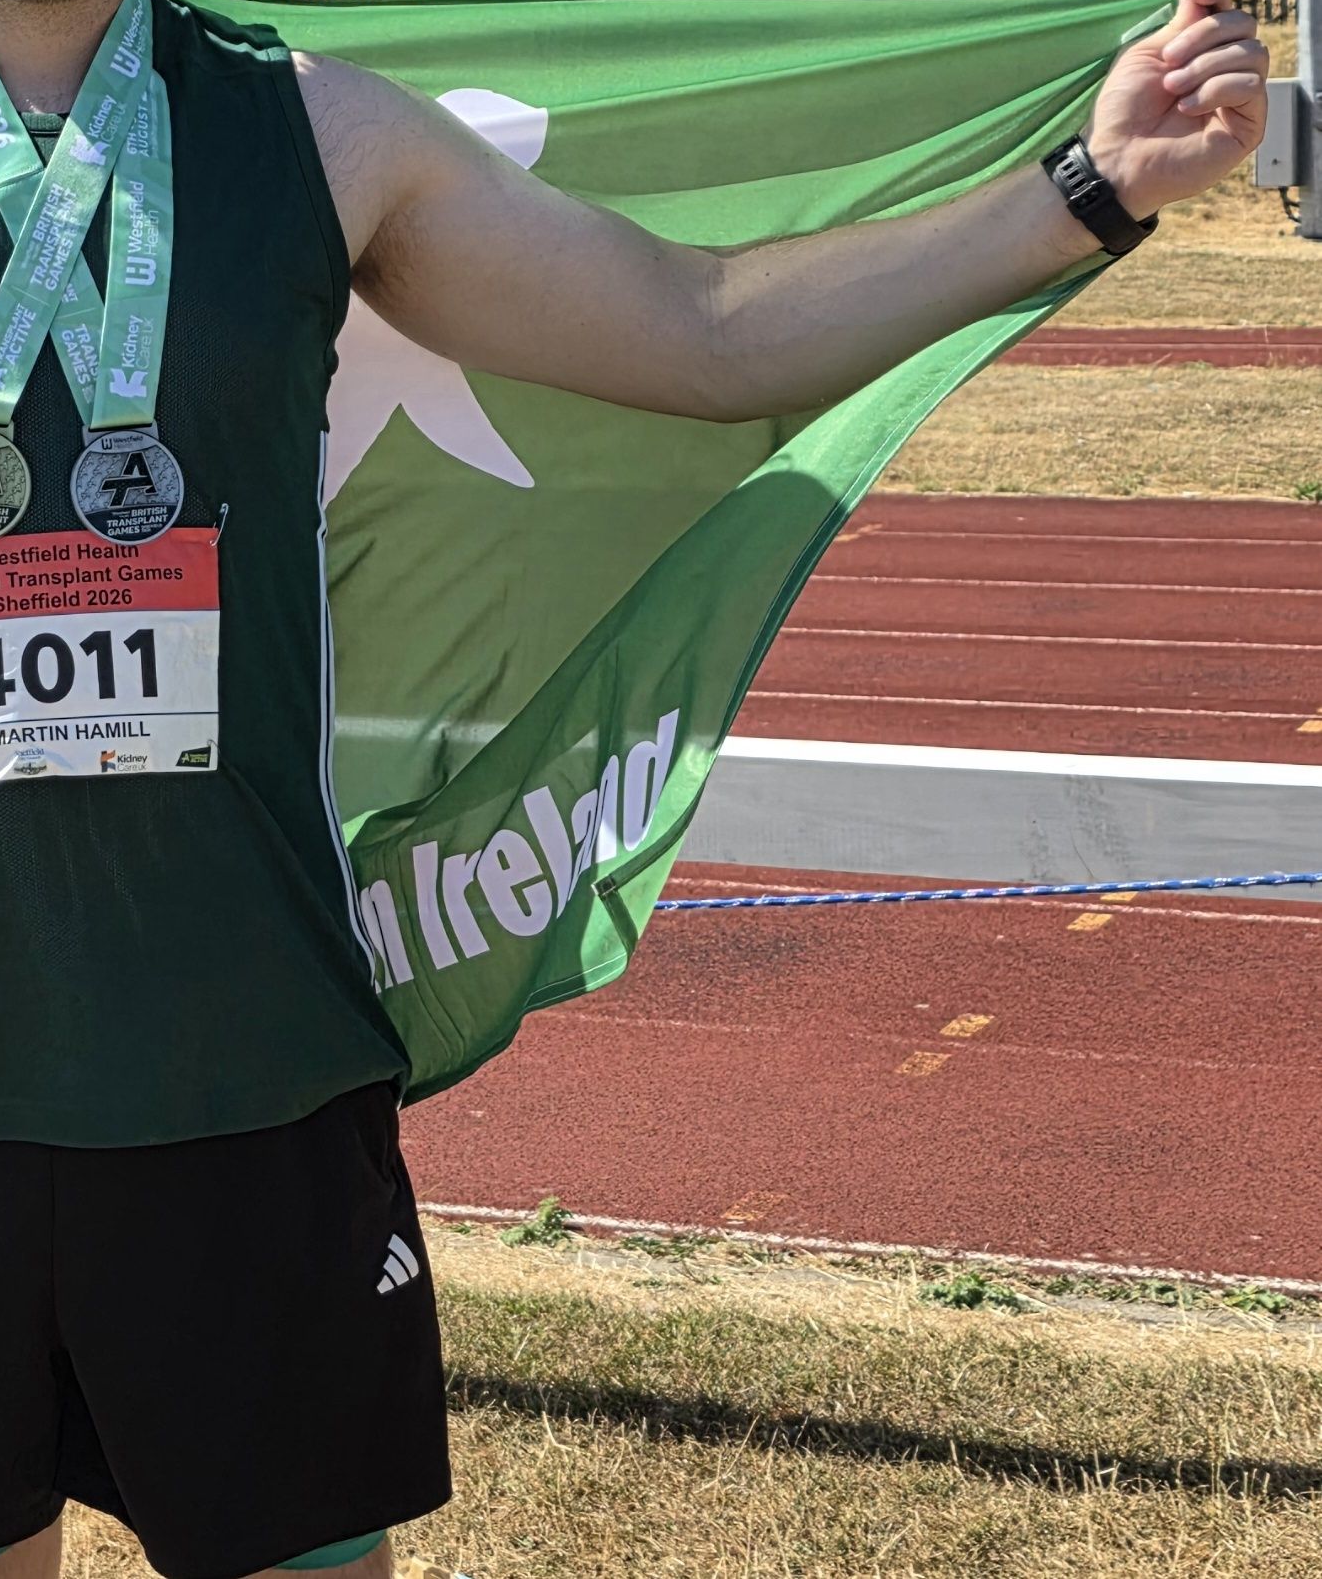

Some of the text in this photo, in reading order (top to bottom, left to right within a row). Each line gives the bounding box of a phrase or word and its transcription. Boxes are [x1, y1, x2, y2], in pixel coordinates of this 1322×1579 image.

[87, 95, 117, 138] Kidney
[101, 112, 123, 143] Care
[139, 106, 150, 157] AUGUST
[127, 132, 138, 155] 6TH
[32, 183, 64, 242] BRITISH
[128, 181, 145, 253] Westfield
[30, 187, 78, 287] TRANSPLANT
[144, 210, 159, 255] Health
[45, 237, 74, 291] GAMES
[5, 309, 37, 367] ACTIVE
[122, 314, 144, 368] Kidney
[136, 330, 152, 369] Care
[62, 330, 91, 385] GAMES
[107, 514, 168, 528] TRANSPLANT
[131, 506, 167, 517] BRITISH
[108, 526, 140, 536] GAMES
[77, 543, 139, 560] Health
[6, 567, 112, 589] Transplant
[118, 564, 183, 581] Games
[87, 588, 132, 606] 2026
[75, 721, 151, 740] HAMILL
[117, 754, 148, 764] Kidney
[118, 763, 138, 772] Care
